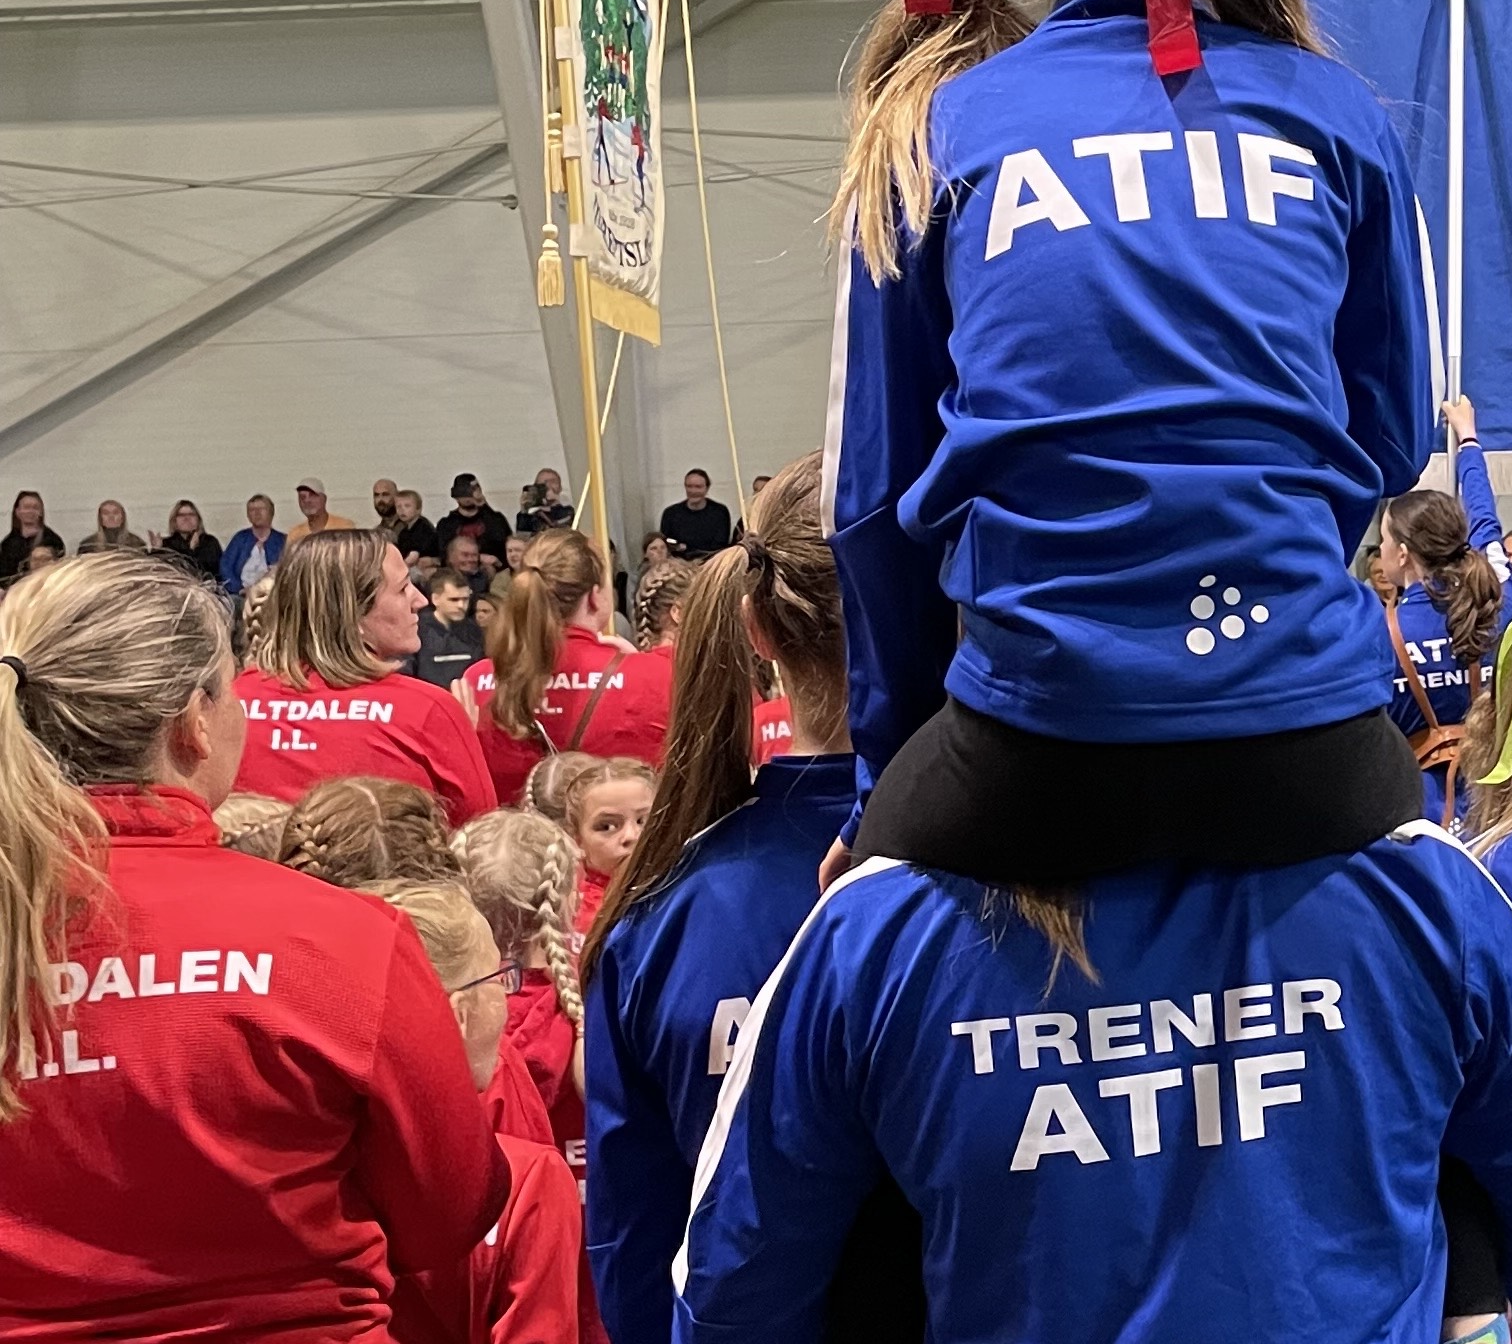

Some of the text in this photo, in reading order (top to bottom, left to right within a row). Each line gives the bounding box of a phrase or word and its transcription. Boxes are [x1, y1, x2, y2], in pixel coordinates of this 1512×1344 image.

[984, 131, 1317, 261] ATIF
[1404, 637, 1456, 664] AT
[240, 699, 393, 723] LTDALEN
[534, 697, 563, 714] .L.
[271, 728, 317, 750] I.L.
[49, 950, 273, 1006] DALEN
[951, 978, 1345, 1074] TRENER
[20, 1030, 117, 1080] .L.
[1009, 1050, 1306, 1172] ATIF
